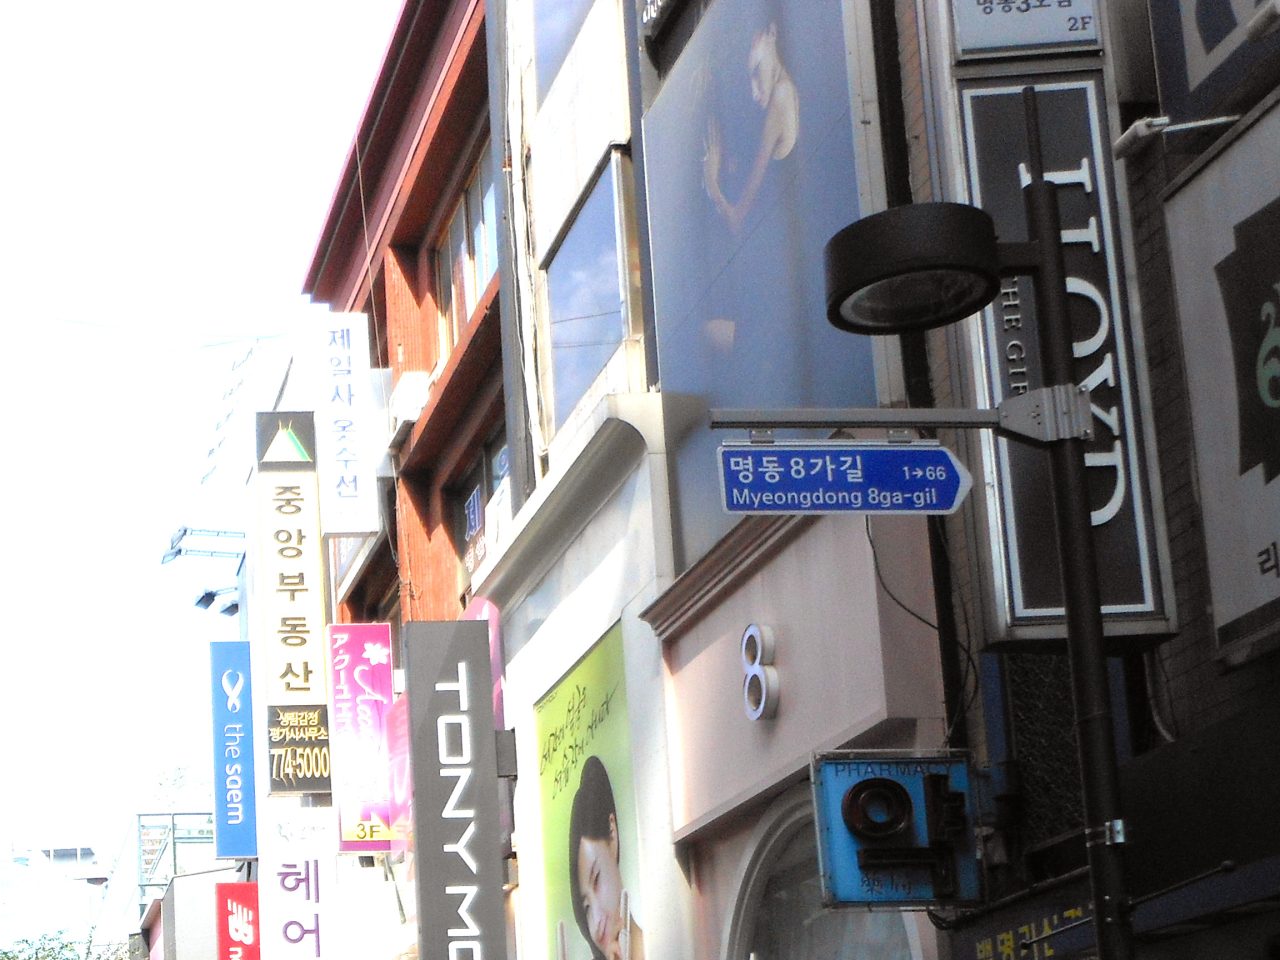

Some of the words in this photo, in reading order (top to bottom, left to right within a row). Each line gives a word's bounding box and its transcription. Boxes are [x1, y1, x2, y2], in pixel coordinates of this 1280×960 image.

[1068, 17, 1092, 32] 2F
[328, 328, 355, 406] 제일사
[332, 418, 359, 498] 옷수선
[730, 455, 863, 483] 명동8가길
[733, 489, 862, 507] Myeongdong
[867, 488, 936, 506] 8ga-gil
[272, 485, 313, 692] 중앙부동산
[741, 623, 774, 721] 8
[224, 723, 244, 760] the
[269, 746, 330, 779] 774-5000
[225, 763, 244, 826] saem
[356, 822, 381, 841] 3F
[276, 859, 321, 958] 헤어
